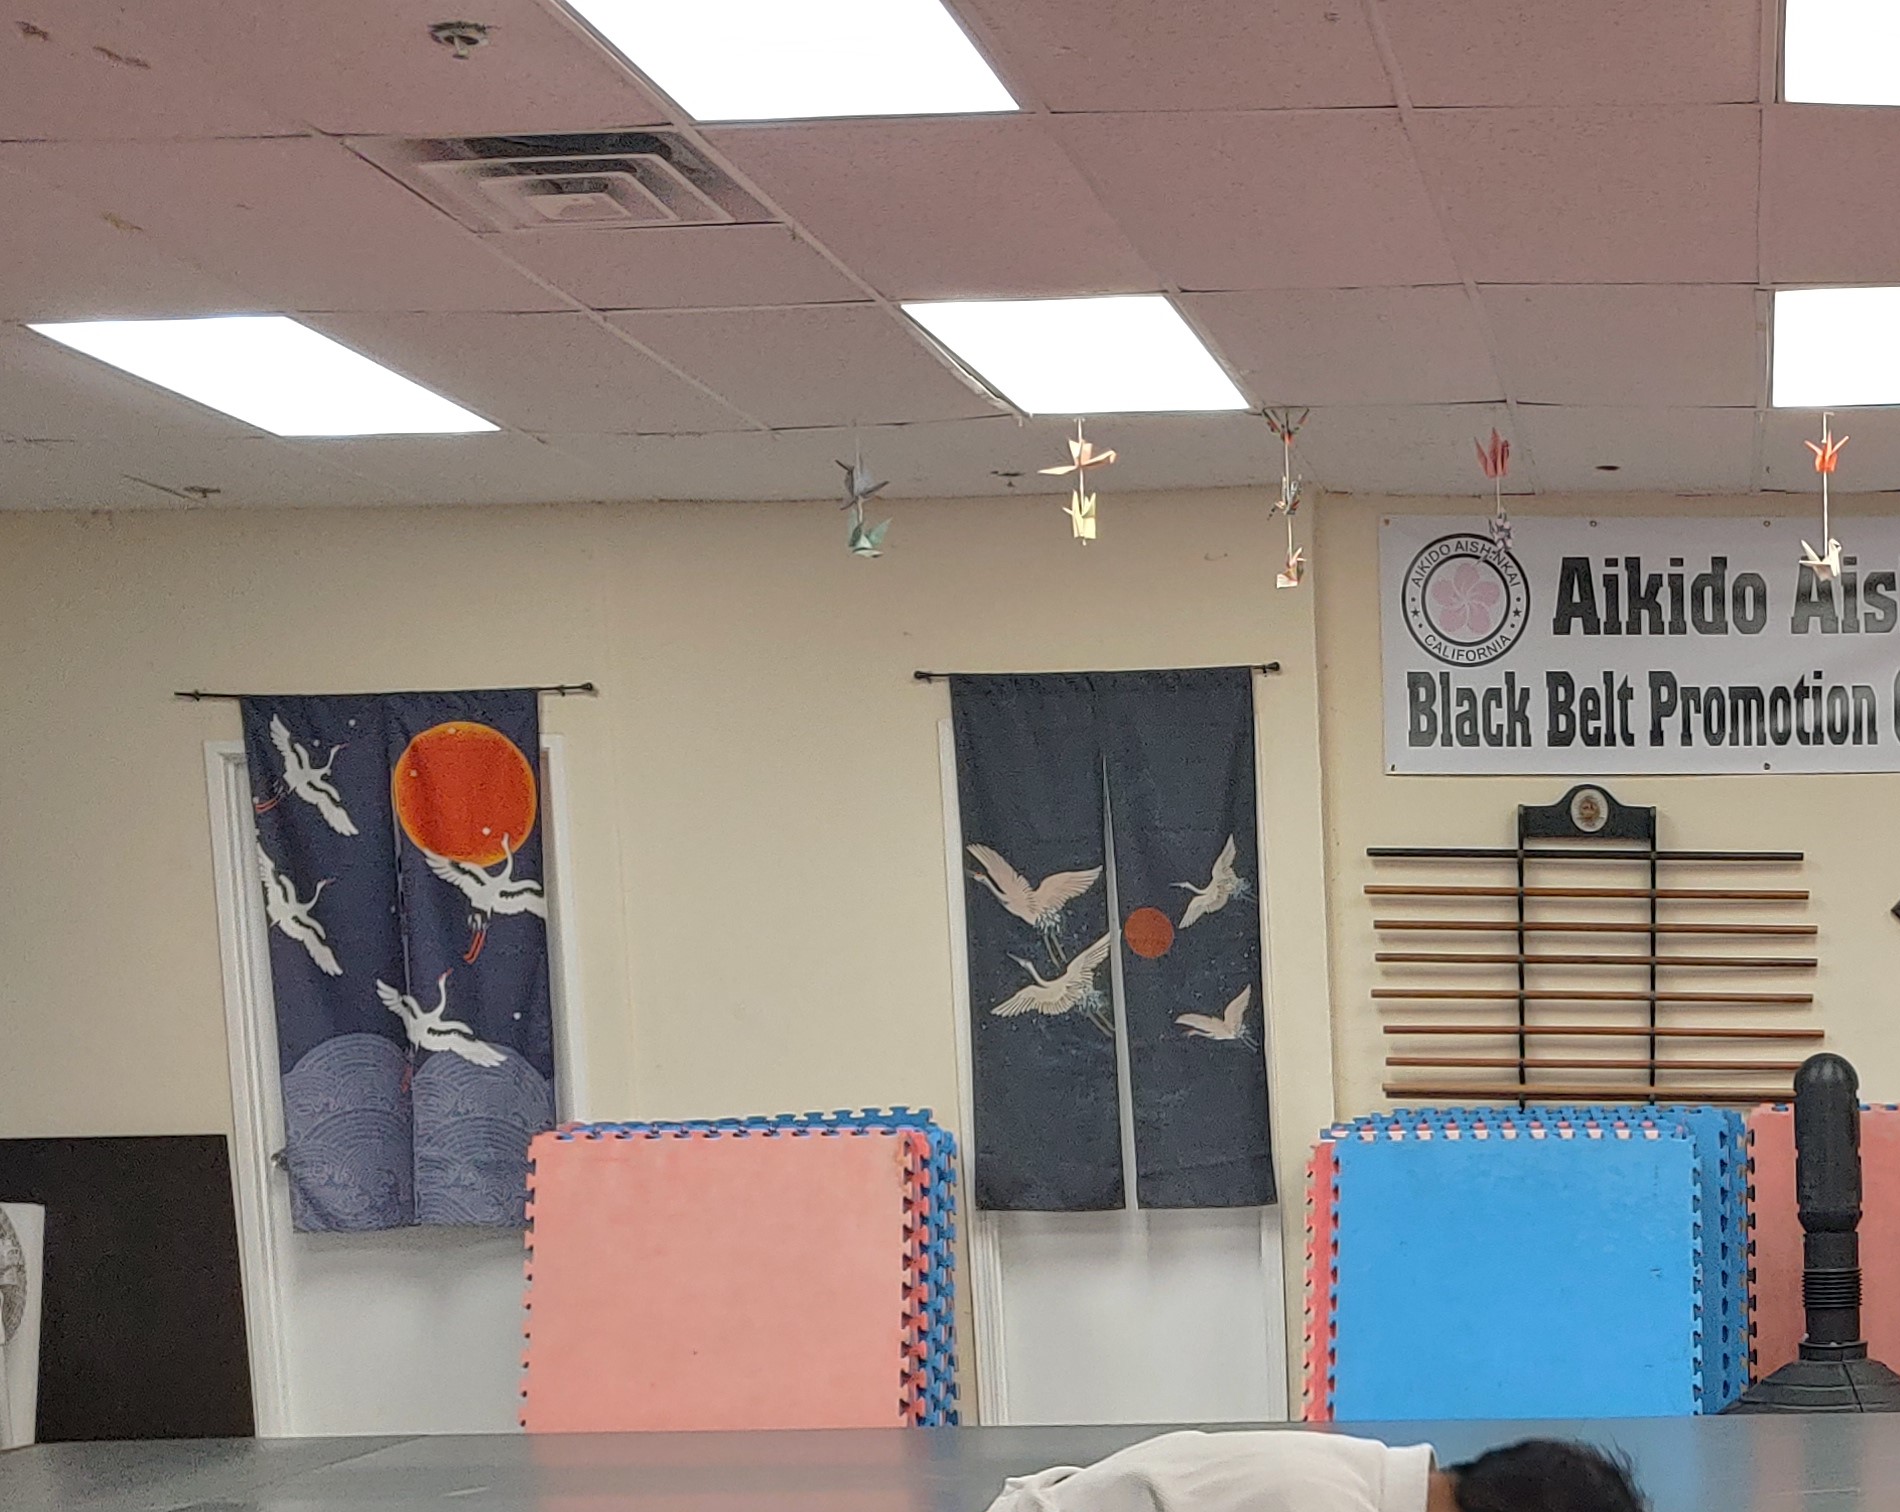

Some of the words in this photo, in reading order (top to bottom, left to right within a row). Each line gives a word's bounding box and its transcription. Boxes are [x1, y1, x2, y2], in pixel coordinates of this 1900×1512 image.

[1411, 544, 1451, 588] AIKIDO
[1552, 556, 1768, 636] Aikido
[1424, 634, 1512, 662] CALIFORNIA
[1407, 671, 1532, 748] Black
[1545, 670, 1635, 747] Belt
[1648, 670, 1878, 747] Promotion
